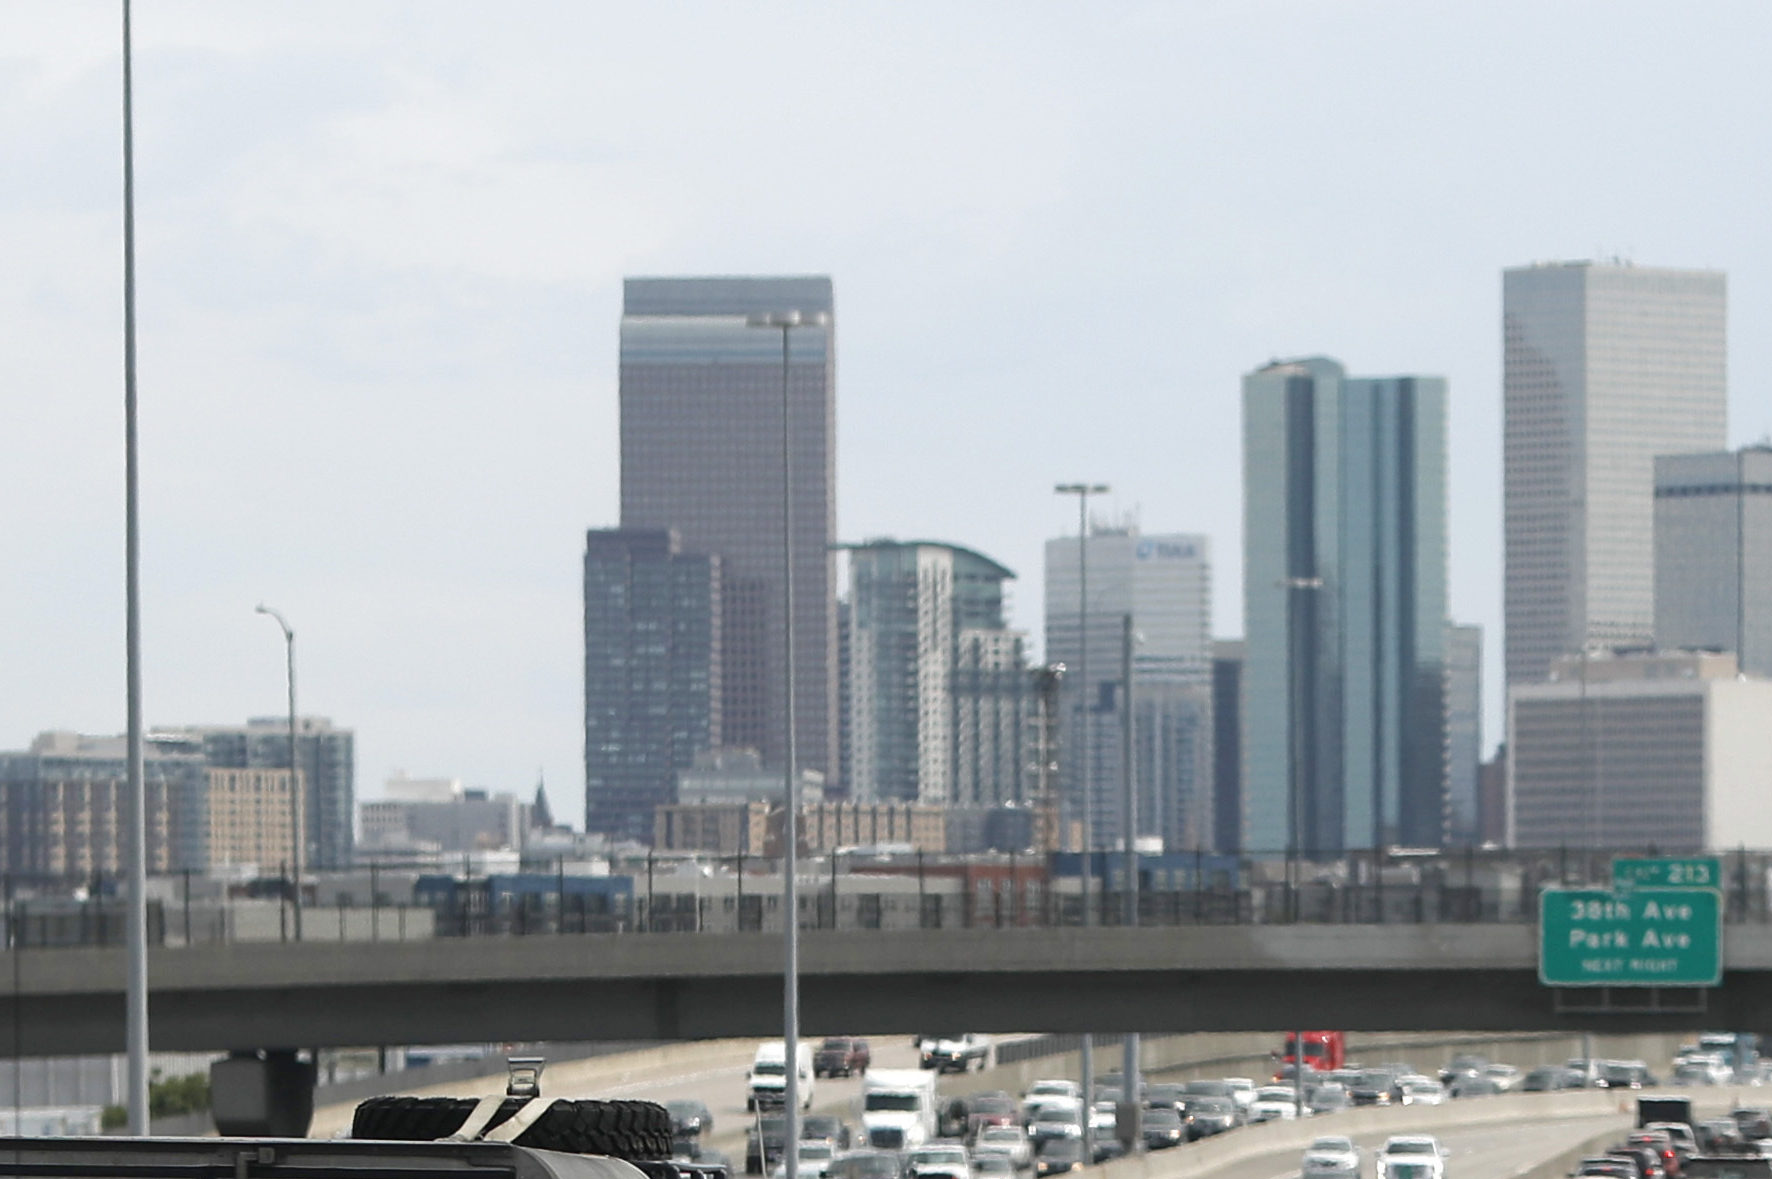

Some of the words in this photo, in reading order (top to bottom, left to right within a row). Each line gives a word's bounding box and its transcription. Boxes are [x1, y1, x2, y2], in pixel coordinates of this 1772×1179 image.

[1667, 863, 1710, 884] 213
[1570, 900, 1631, 920] 38th
[1642, 900, 1693, 920] Ave
[1568, 929, 1629, 948] Park
[1641, 929, 1691, 949] Ave
[1581, 958, 1624, 972] NEXT
